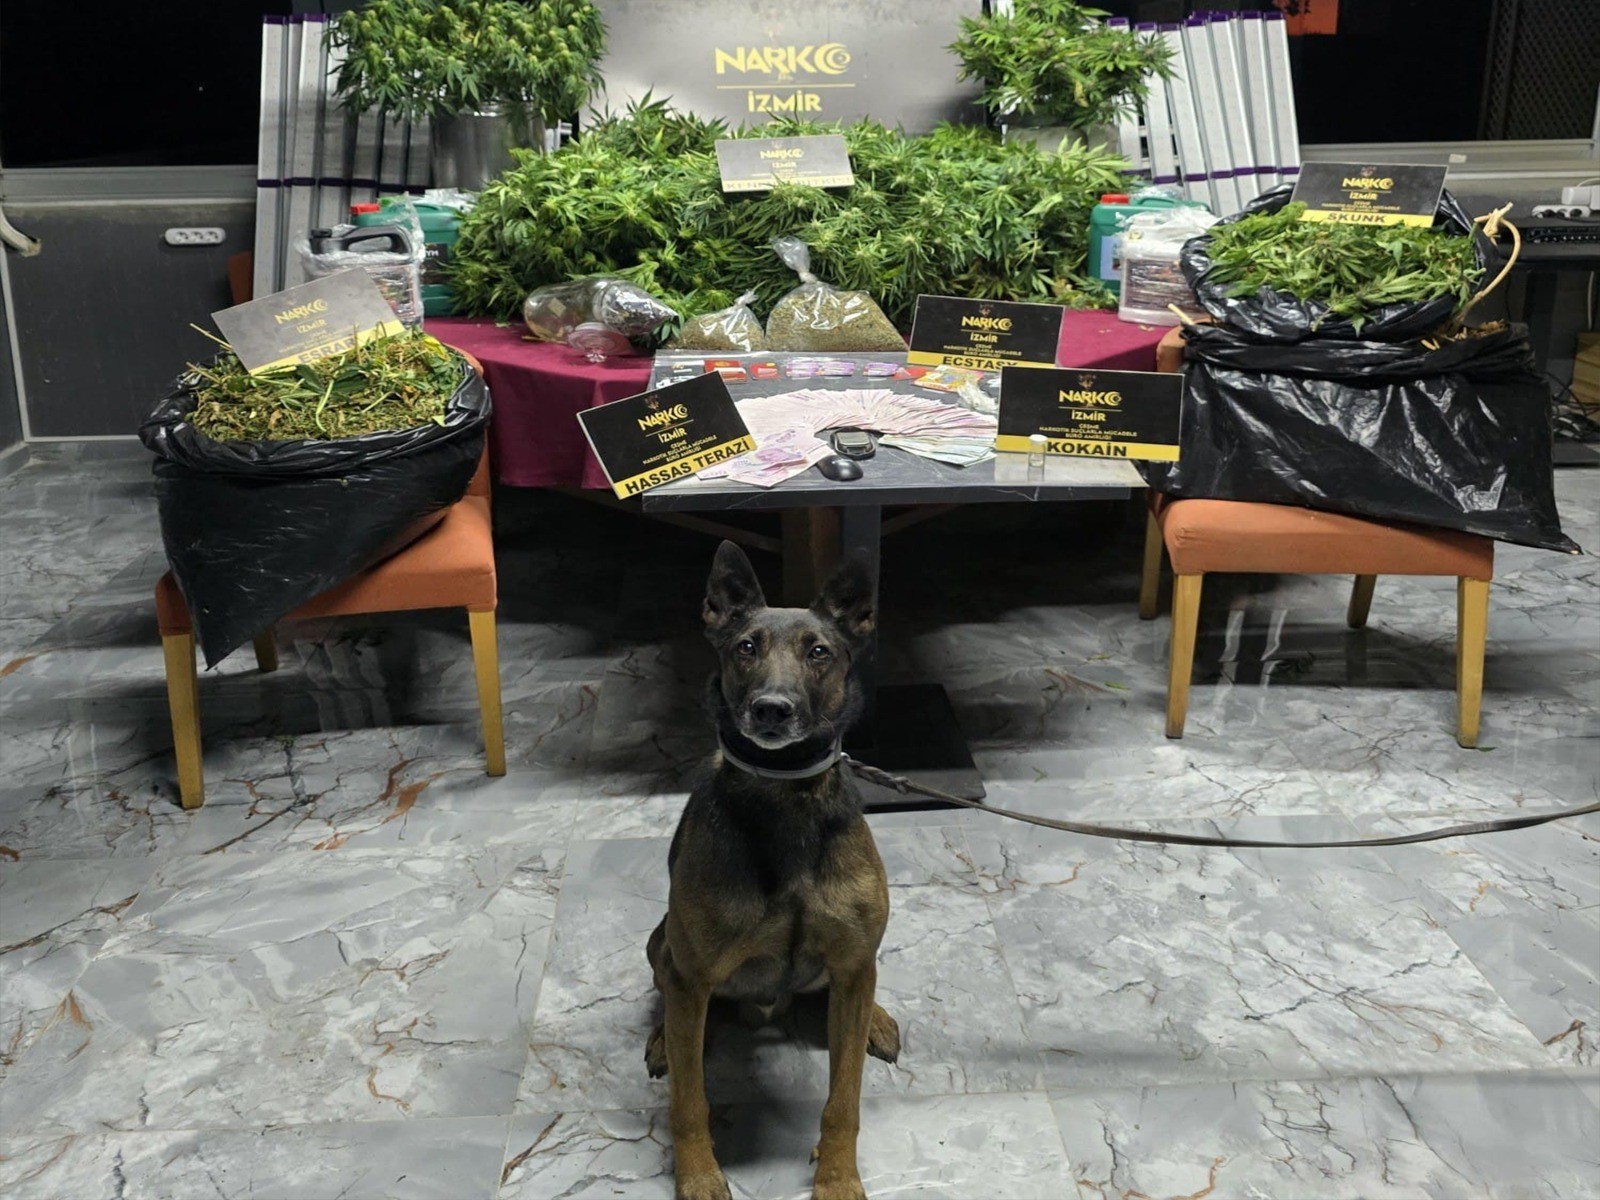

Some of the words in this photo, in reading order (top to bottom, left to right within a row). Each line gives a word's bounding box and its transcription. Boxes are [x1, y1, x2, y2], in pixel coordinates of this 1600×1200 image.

[714, 42, 851, 75] NARKO
[747, 89, 823, 113] İZMİR
[1342, 177, 1394, 190] NARKO
[1349, 191, 1378, 200] İZMİR
[1328, 212, 1387, 223] SKUNK
[274, 298, 328, 325] NARKO
[296, 319, 328, 334] İZMİR
[961, 315, 1013, 331] NARKO
[970, 332, 998, 343] İZMİR
[297, 337, 355, 364] ESRAR
[1058, 389, 1122, 406] NARKO
[637, 403, 688, 431] NARKO
[1071, 409, 1106, 422] İZMİR
[657, 427, 688, 443] İZMİR
[1046, 441, 1127, 457] KOKAİN
[625, 462, 692, 494] HASSAS
[693, 439, 751, 468] TERAZİ
